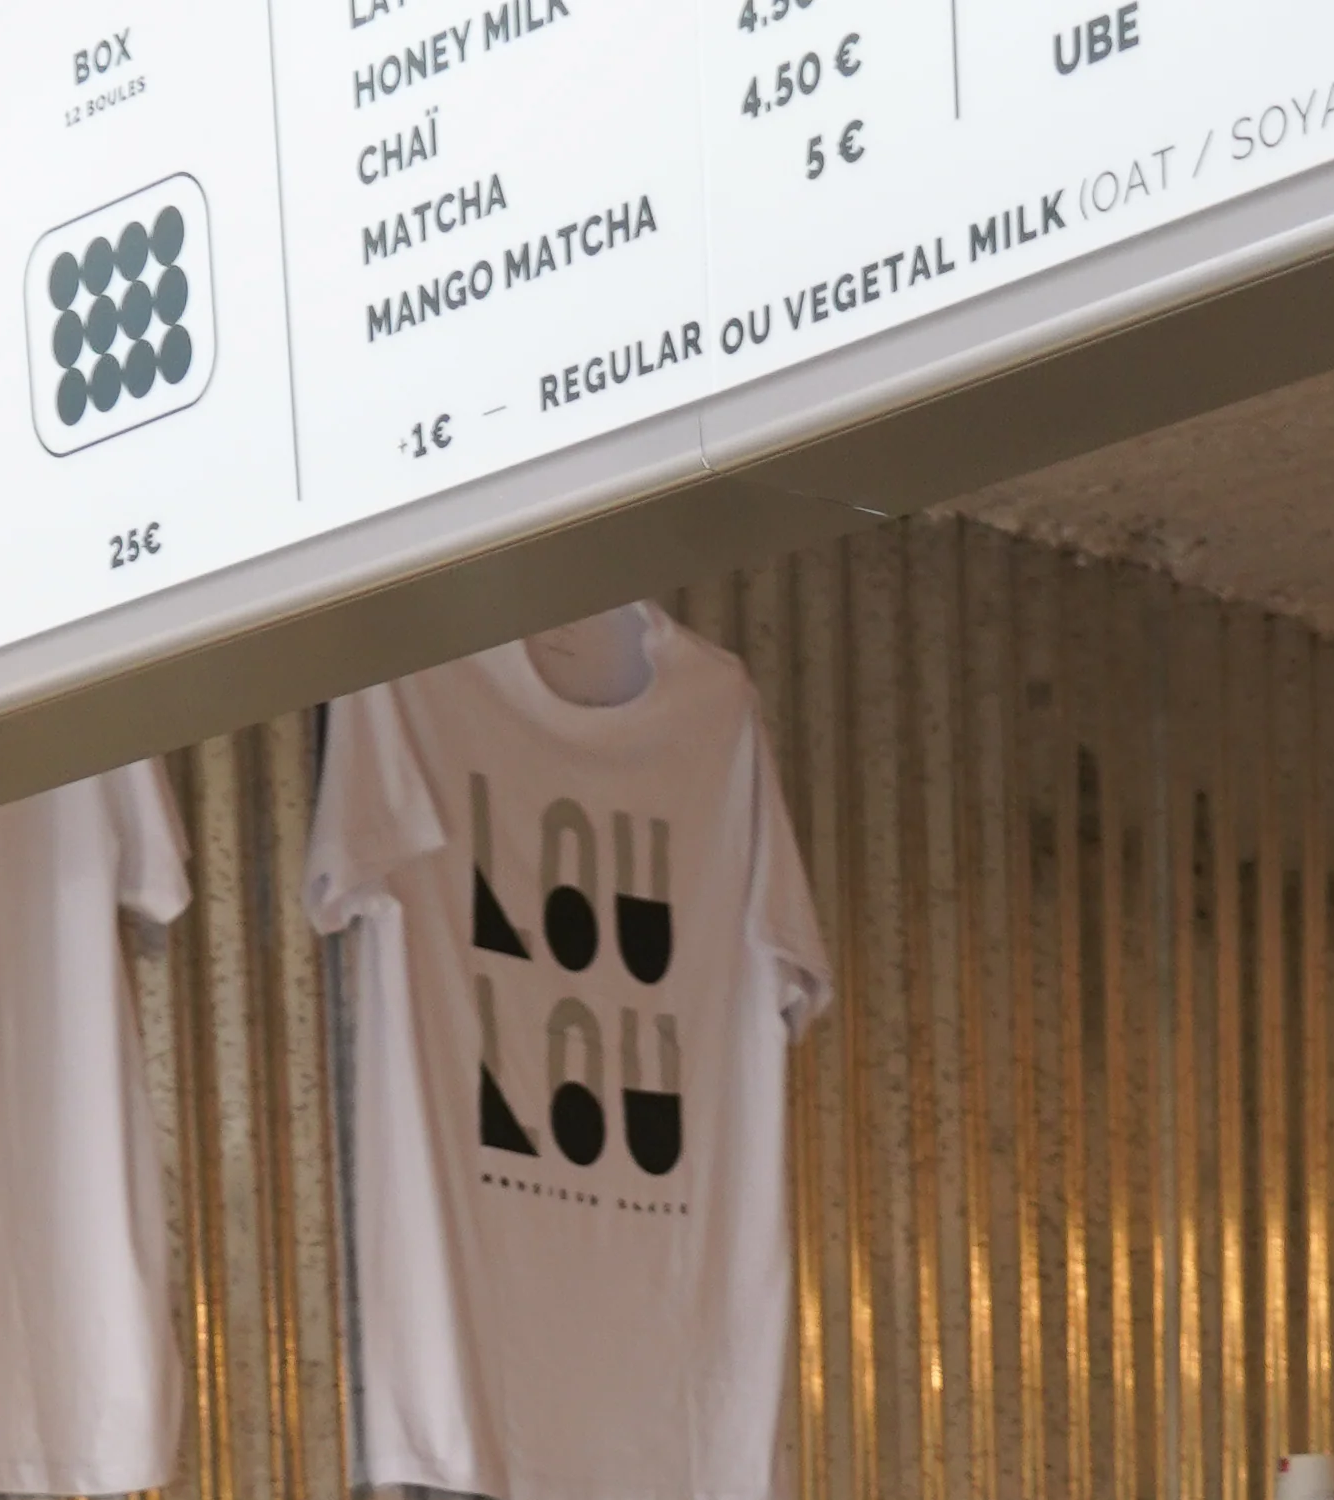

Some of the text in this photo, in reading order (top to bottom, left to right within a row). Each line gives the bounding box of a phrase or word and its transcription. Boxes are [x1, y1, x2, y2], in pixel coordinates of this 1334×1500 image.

[74, 28, 131, 85] BOX
[354, 0, 570, 108] HONEY MILK
[742, 32, 862, 118] 4.50 €
[1054, 1, 1139, 75] UBE
[65, 76, 146, 127] 12 BOULES
[357, 106, 438, 185] CHAÏ
[806, 120, 865, 180] 5 €
[362, 173, 507, 265] MATCHA
[367, 195, 657, 342] MANGO MATCHA
[540, 321, 703, 411] REGULAR
[720, 304, 770, 355] OU
[784, 237, 955, 330] VEGETAL
[969, 189, 1066, 262] MILK
[1079, 145, 1176, 220] (OAT
[109, 522, 161, 569] 25€
